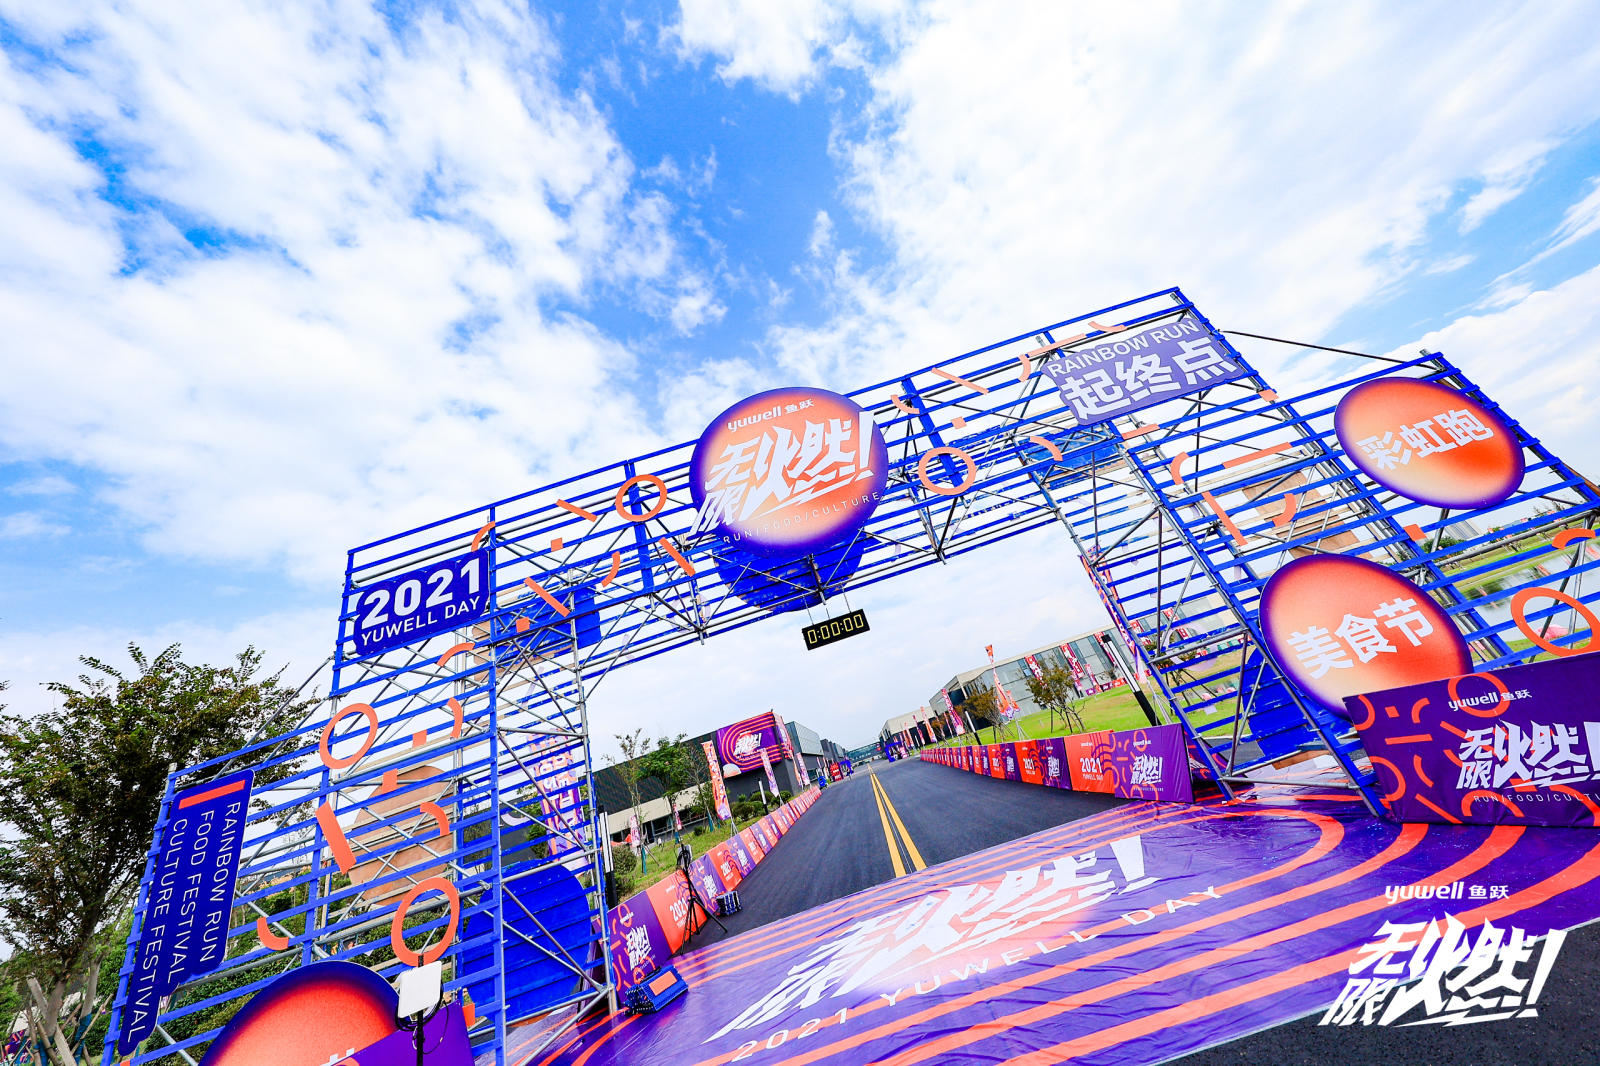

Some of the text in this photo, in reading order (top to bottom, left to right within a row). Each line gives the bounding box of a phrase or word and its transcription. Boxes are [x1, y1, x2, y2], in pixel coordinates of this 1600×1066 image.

[1047, 320, 1200, 378] RAINBOW RUN
[1060, 336, 1238, 420] 起终点
[728, 399, 814, 432] yuwell 鱼跃
[1356, 409, 1494, 470] 彩虹跑
[361, 558, 480, 630] 2021
[361, 595, 480, 646] YUWELL DAY
[808, 614, 864, 644] 0:00:00
[1286, 597, 1434, 680] 美食节
[1448, 689, 1532, 711] yuwell 鱼跃
[1081, 757, 1103, 773] 2021
[167, 810, 215, 984] FOOD FESTIVAL
[200, 801, 241, 963] RAINBOW RUN
[127, 818, 188, 1043] CULTURE FESTIVAL
[731, 885, 1222, 1063] 2021 YUWELL DAY
